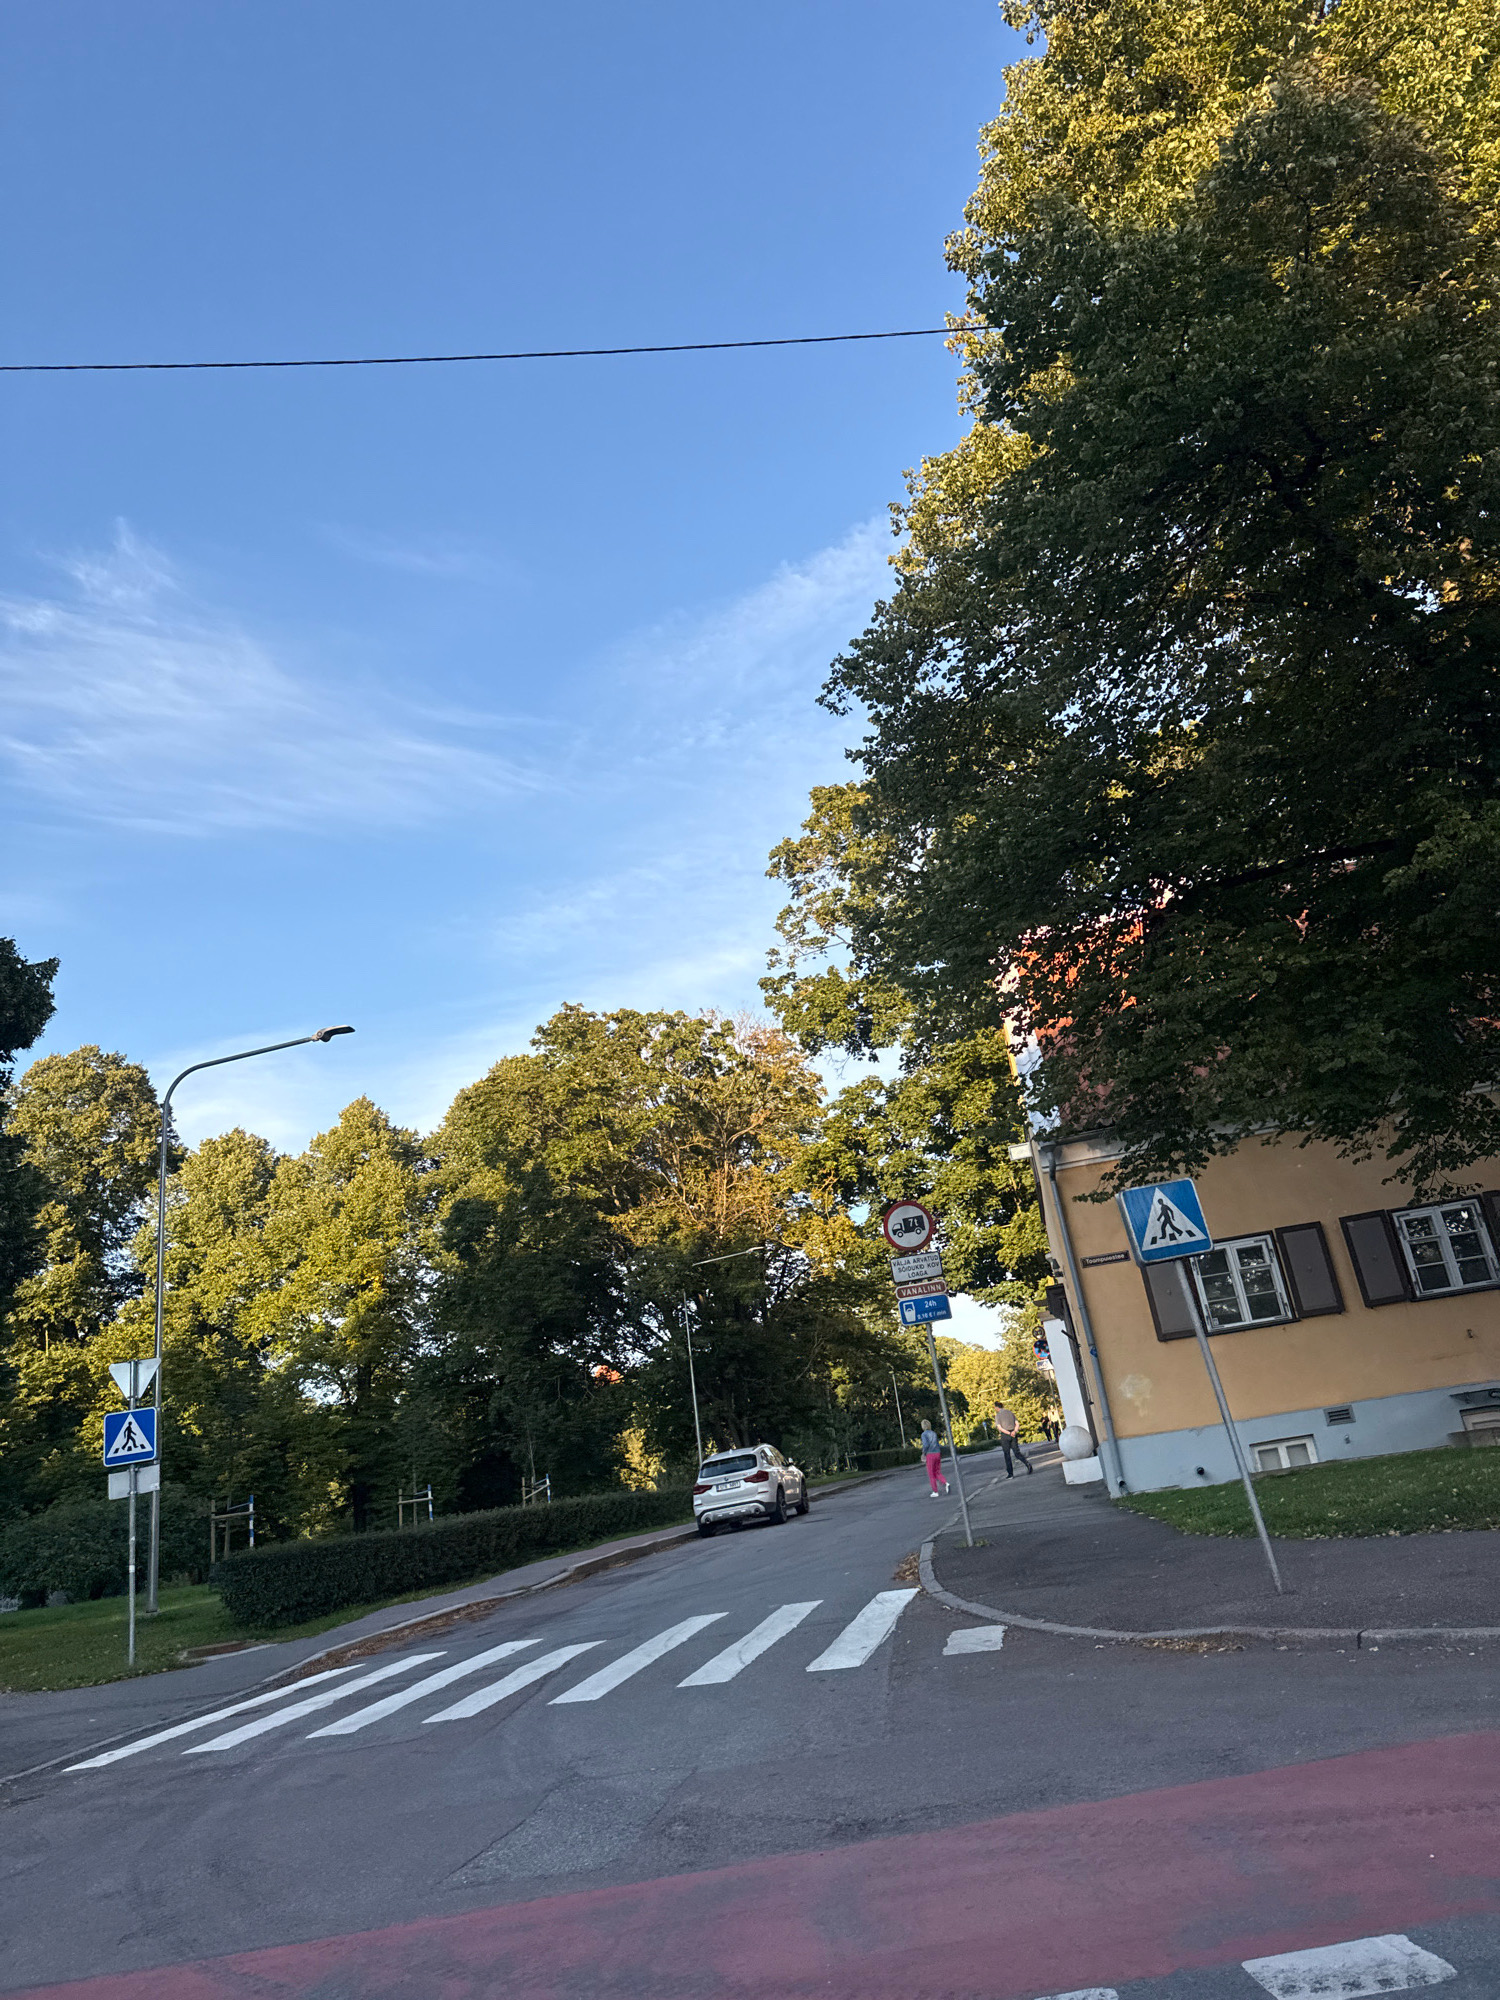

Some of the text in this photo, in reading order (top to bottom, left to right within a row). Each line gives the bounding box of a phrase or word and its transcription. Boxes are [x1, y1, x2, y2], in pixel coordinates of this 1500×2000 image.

[908, 1218, 919, 1227] 7t
[893, 1255, 938, 1267] VÄLJA ARVATUD
[898, 1264, 924, 1273] SÕIDUKID
[901, 1285, 942, 1296] VANALINN
